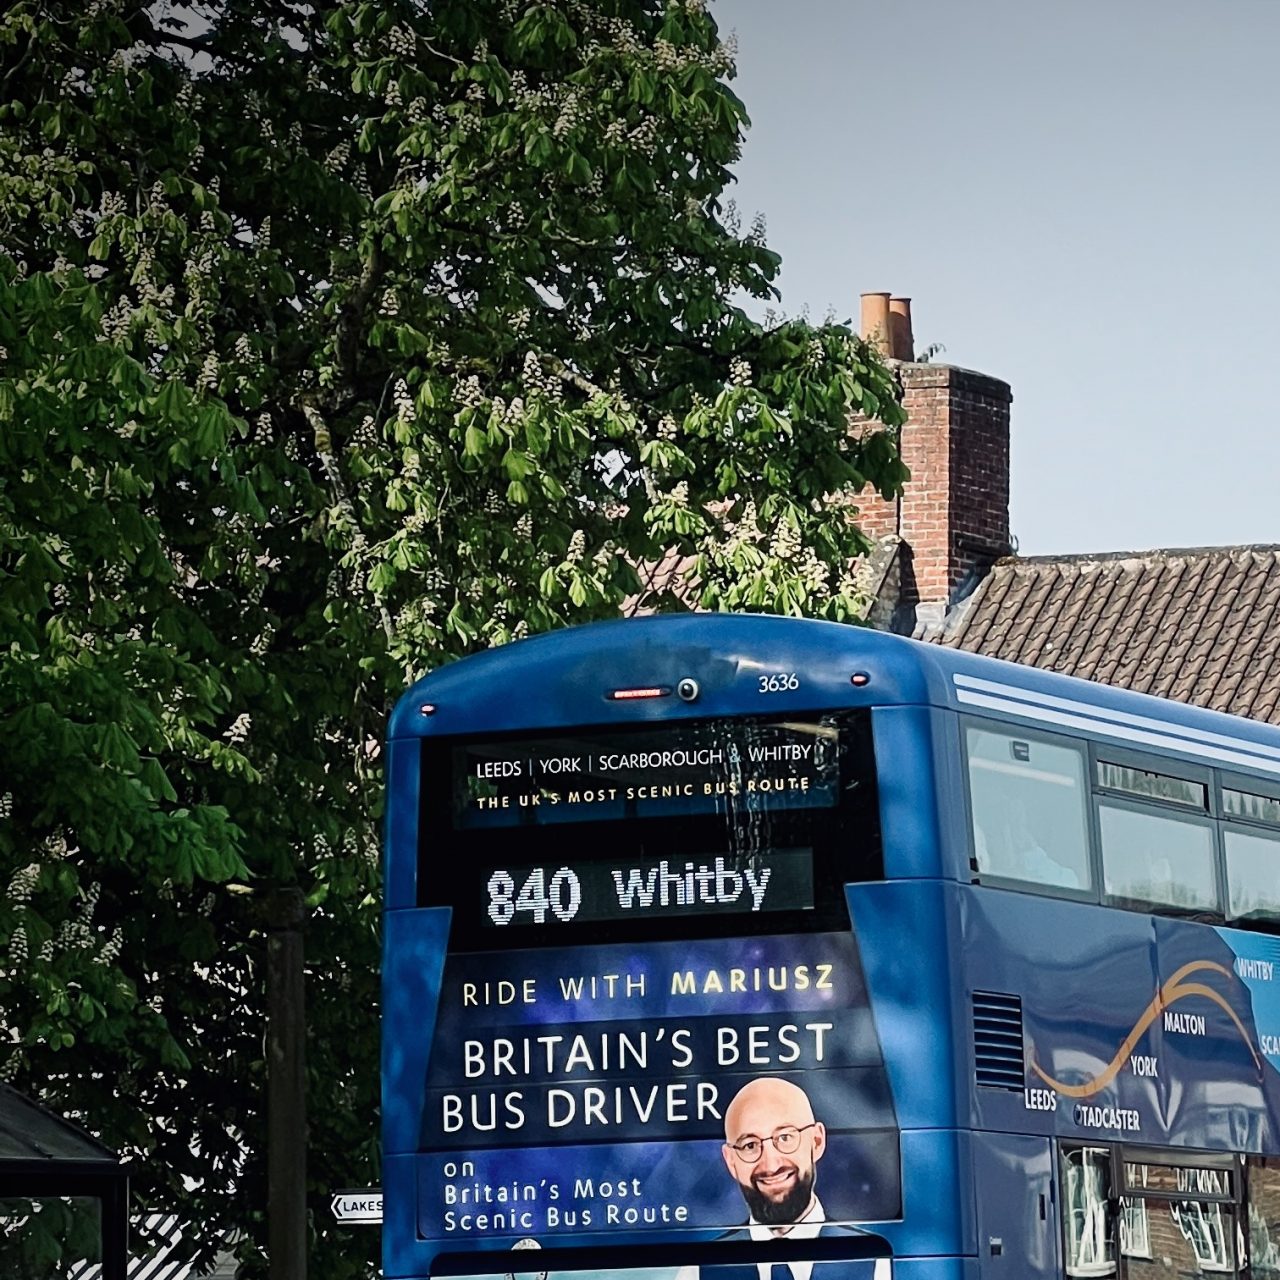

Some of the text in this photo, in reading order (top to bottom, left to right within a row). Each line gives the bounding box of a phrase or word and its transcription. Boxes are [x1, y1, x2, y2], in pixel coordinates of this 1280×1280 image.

[758, 673, 799, 693] 3636
[476, 760, 522, 778] LEEDS
[539, 757, 582, 773] YORK
[599, 749, 723, 771] SCARBOROUGH
[749, 744, 812, 762] WHITBY
[476, 796, 510, 809] THE
[568, 789, 617, 803] MOST
[626, 784, 694, 800] SCENIC
[703, 780, 738, 795] BUS
[747, 777, 810, 792] ROUTE
[487, 857, 771, 926] 840 Whitby
[1236, 956, 1274, 981] WHITBY
[463, 964, 833, 1006] RIDE WITH MARIUSZ
[1164, 1011, 1206, 1036] MALTON
[464, 1023, 833, 1078] BRITAIN'S BEST
[1130, 1055, 1158, 1078] YORK
[442, 1082, 723, 1133] BUS DRIVER
[1024, 1087, 1057, 1111] LEEDS
[1081, 1105, 1141, 1131] TADCASTER
[443, 1160, 475, 1178] on
[444, 1177, 642, 1204] Britain's Most
[343, 1200, 383, 1212] LAKES
[444, 1202, 689, 1231] Scenic Bus Route
